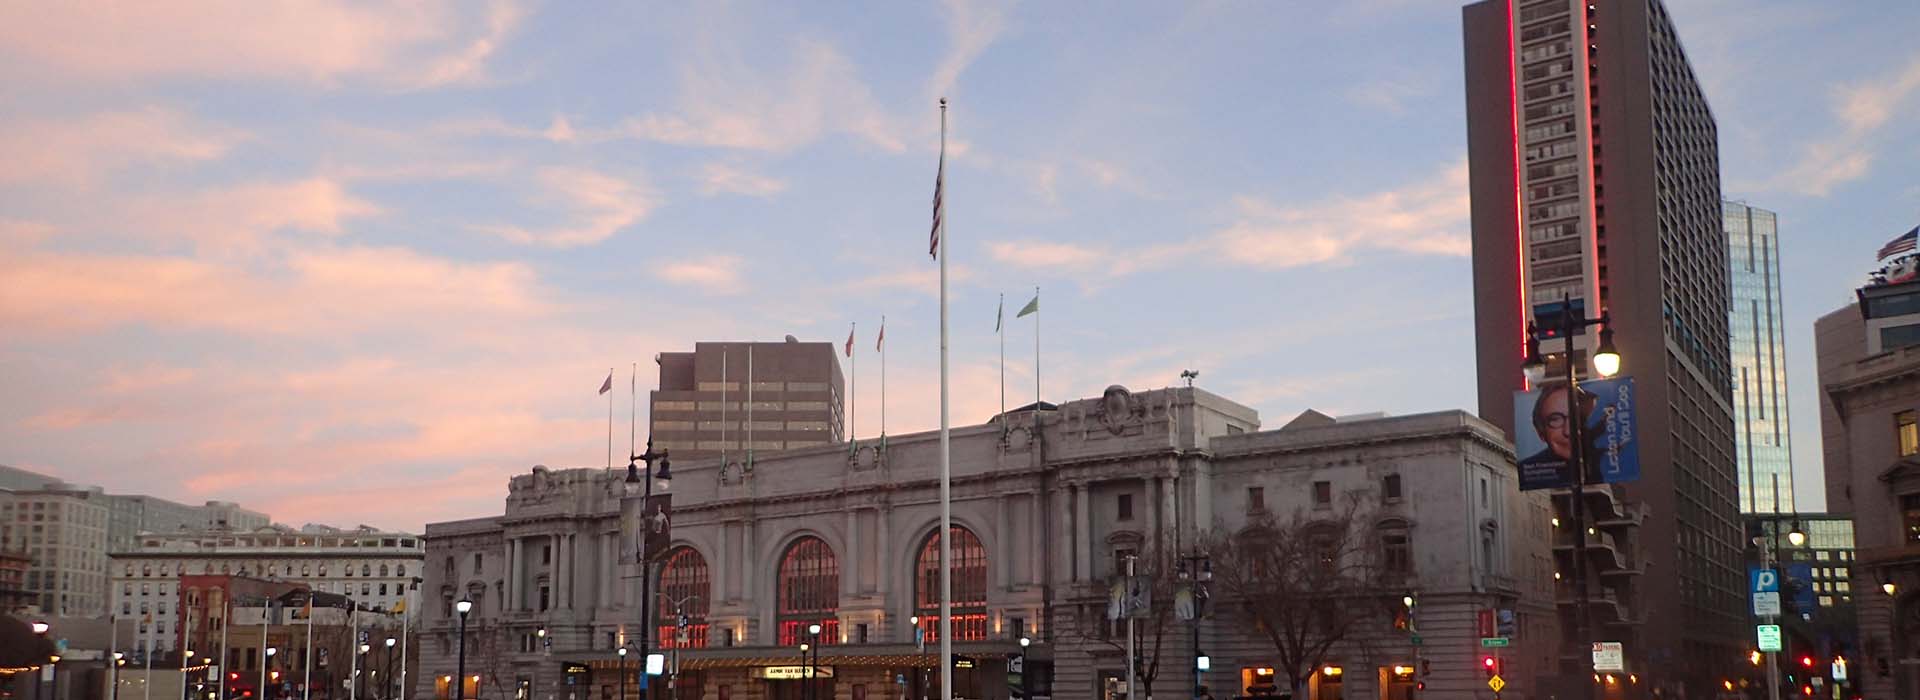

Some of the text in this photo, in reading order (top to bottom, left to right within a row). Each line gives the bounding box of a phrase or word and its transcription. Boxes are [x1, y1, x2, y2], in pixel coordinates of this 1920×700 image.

[1617, 384, 1630, 411] See
[1604, 407, 1620, 474] Listen and
